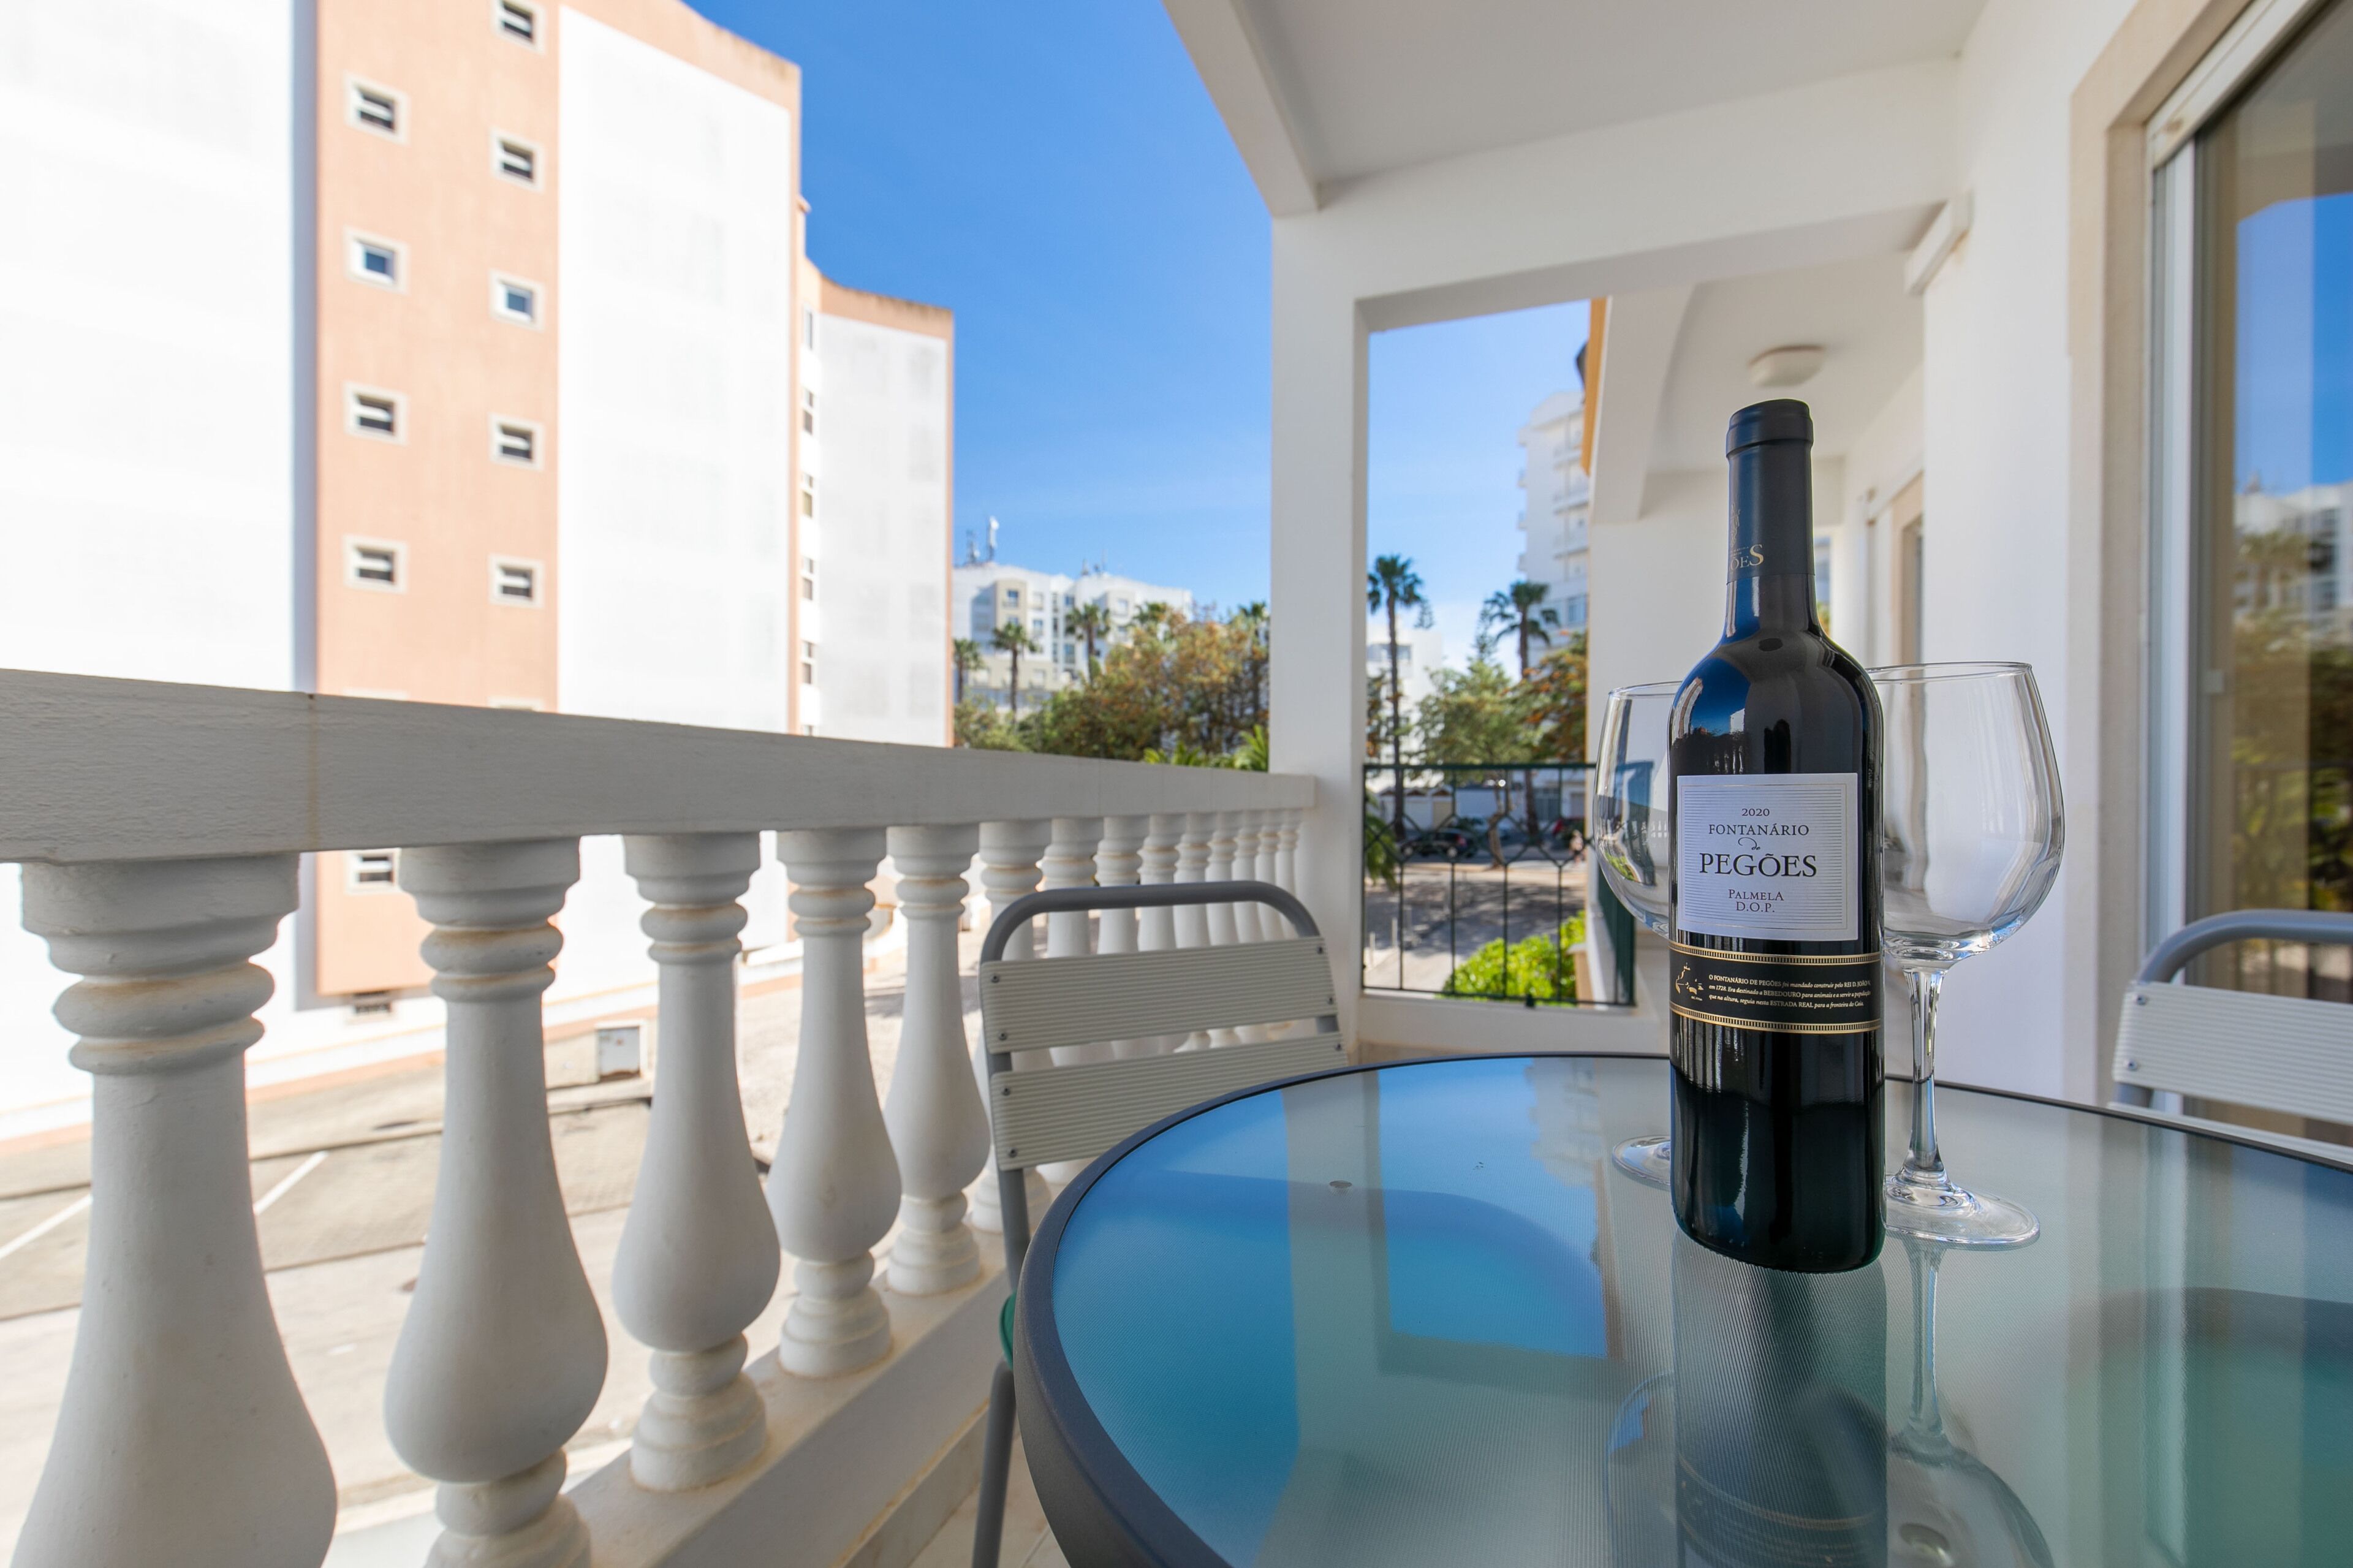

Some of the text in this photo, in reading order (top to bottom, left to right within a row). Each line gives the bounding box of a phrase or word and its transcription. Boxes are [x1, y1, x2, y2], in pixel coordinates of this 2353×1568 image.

[1708, 824, 1809, 836] FONTANÁRIO
[1738, 837, 1760, 850] de
[1699, 853, 1817, 877] PEGÕES
[1729, 889, 1784, 901] PALMELA
[1737, 901, 1775, 912] D.O.P.
[1714, 975, 1749, 984] FONTANÁRIO
